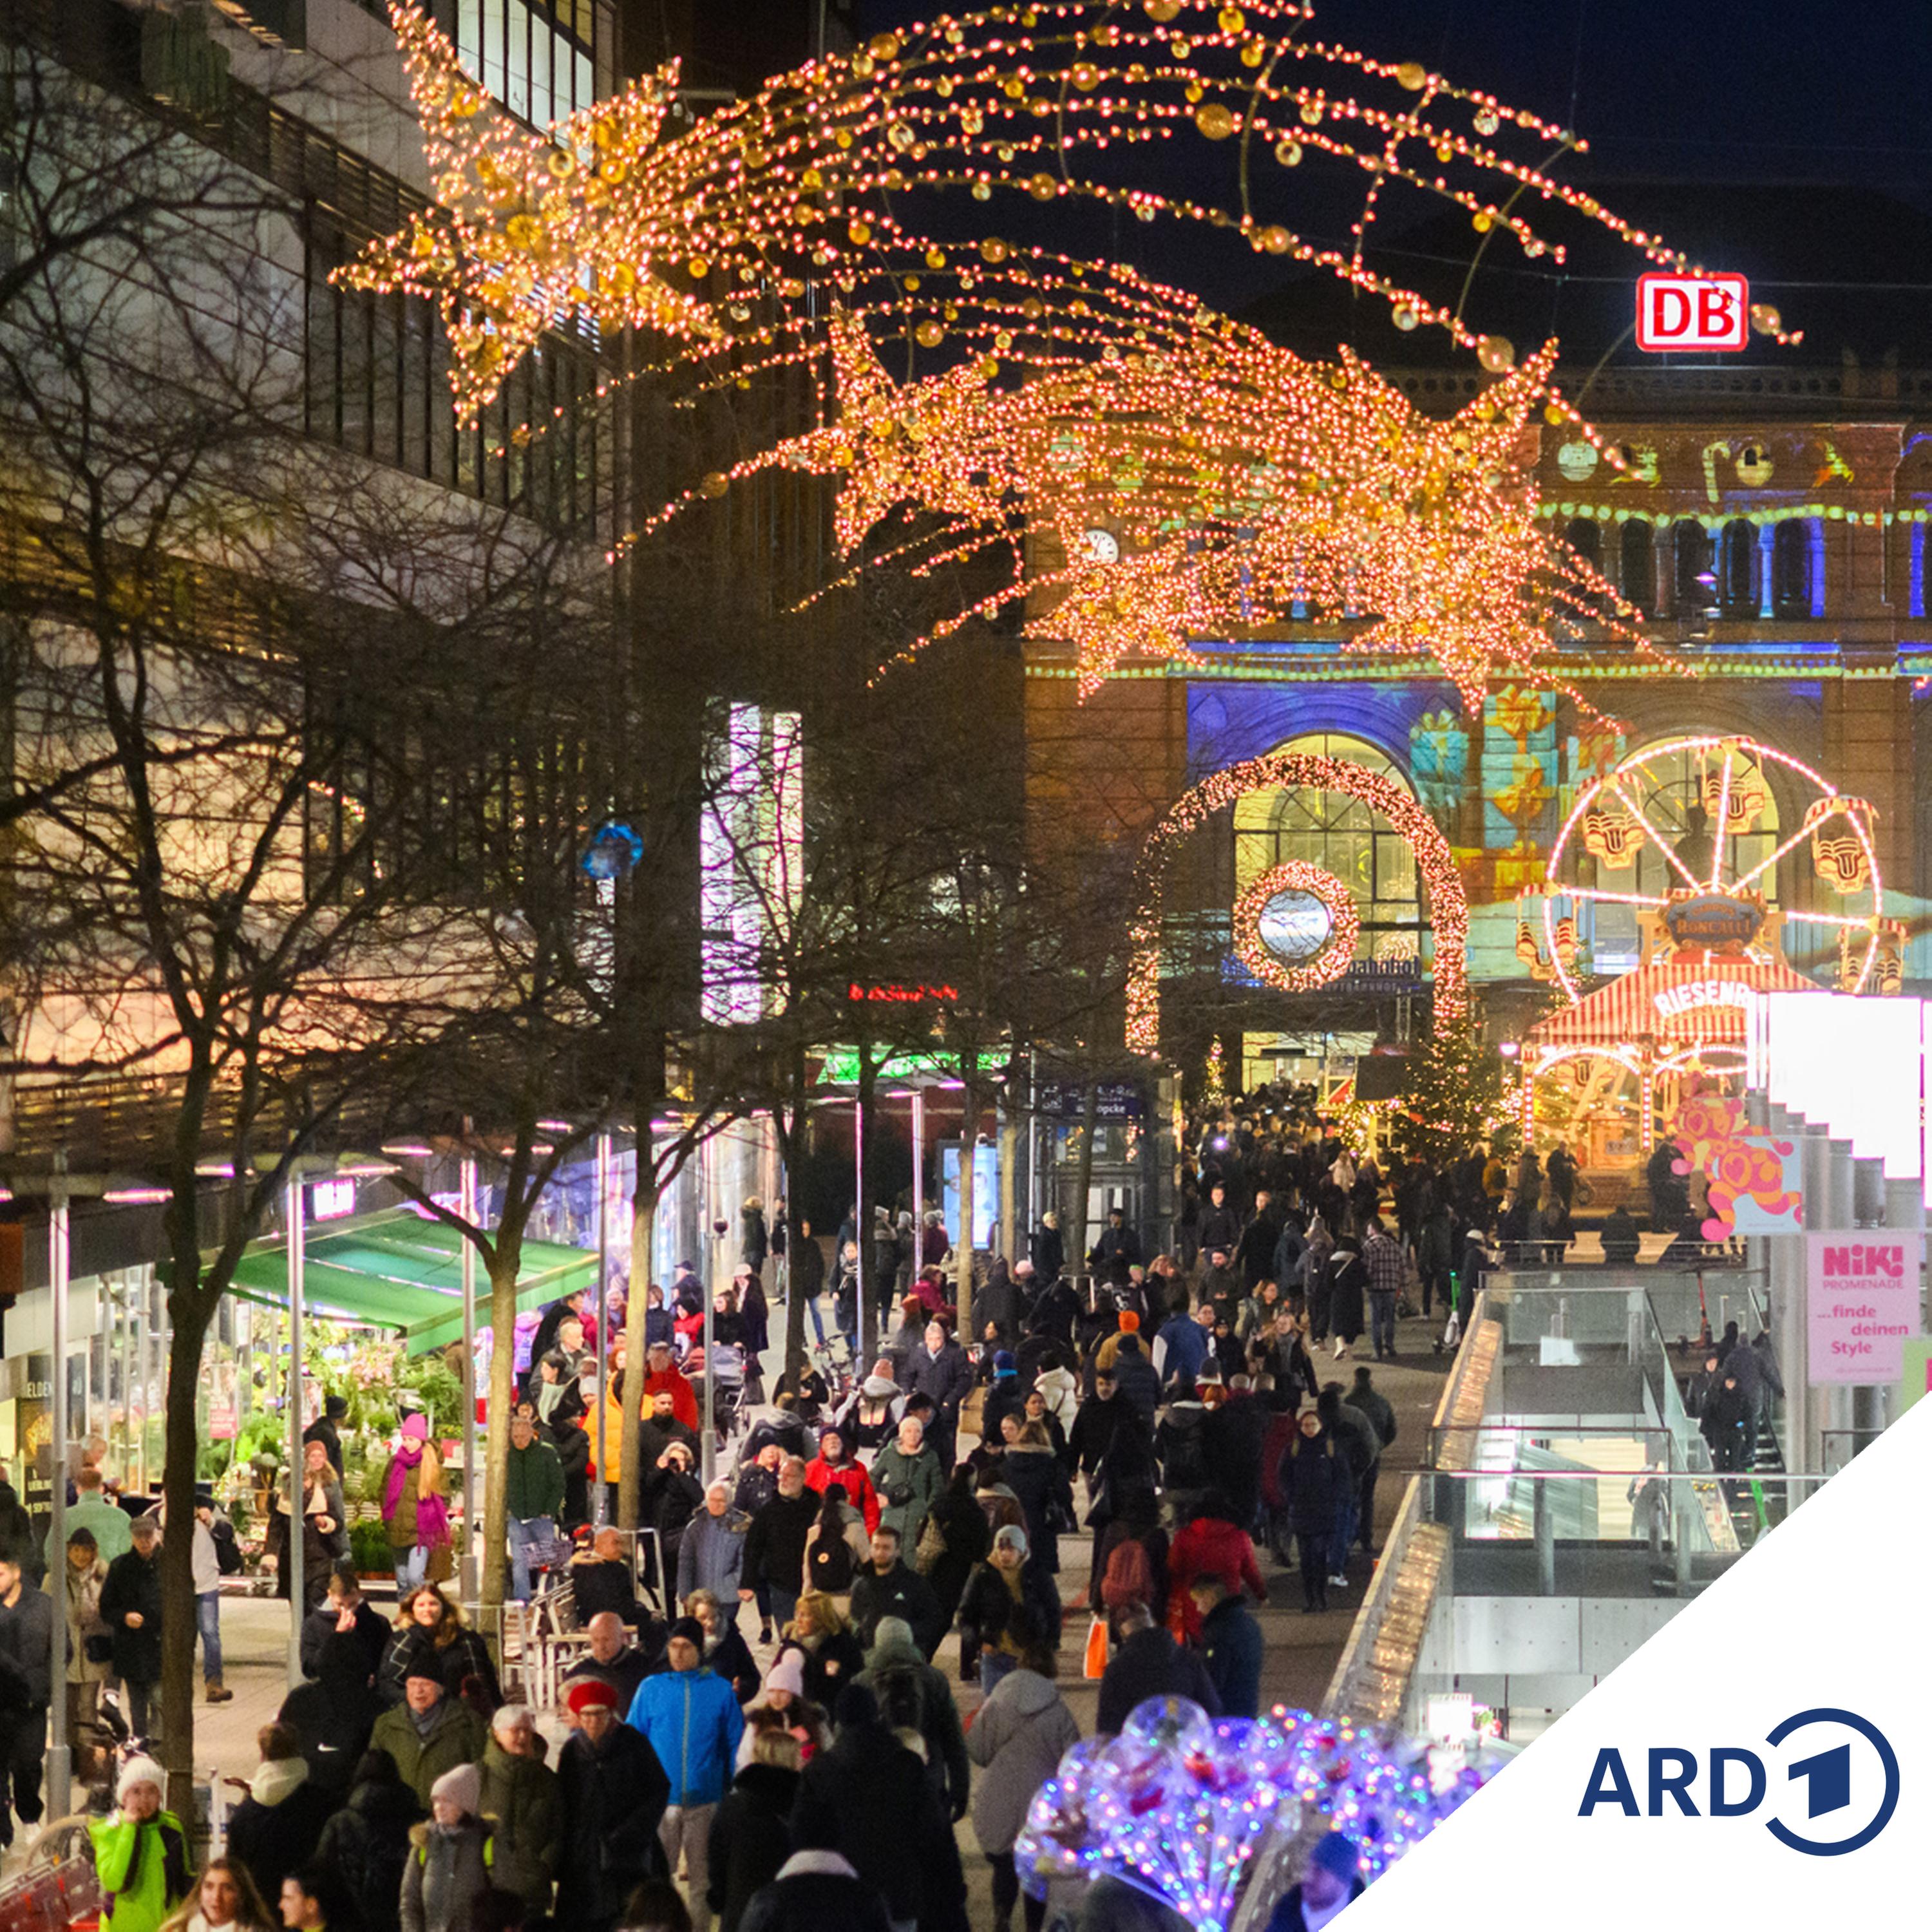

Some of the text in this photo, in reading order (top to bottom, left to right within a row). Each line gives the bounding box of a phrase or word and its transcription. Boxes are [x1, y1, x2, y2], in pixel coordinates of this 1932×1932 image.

[1653, 287, 1735, 337] DB
[1654, 979, 1749, 1018] RIESENR
[1823, 1279, 1904, 1290] PROMENADE
[1851, 1322, 1909, 1336] deinen
[1831, 1341, 1873, 1358] Style
